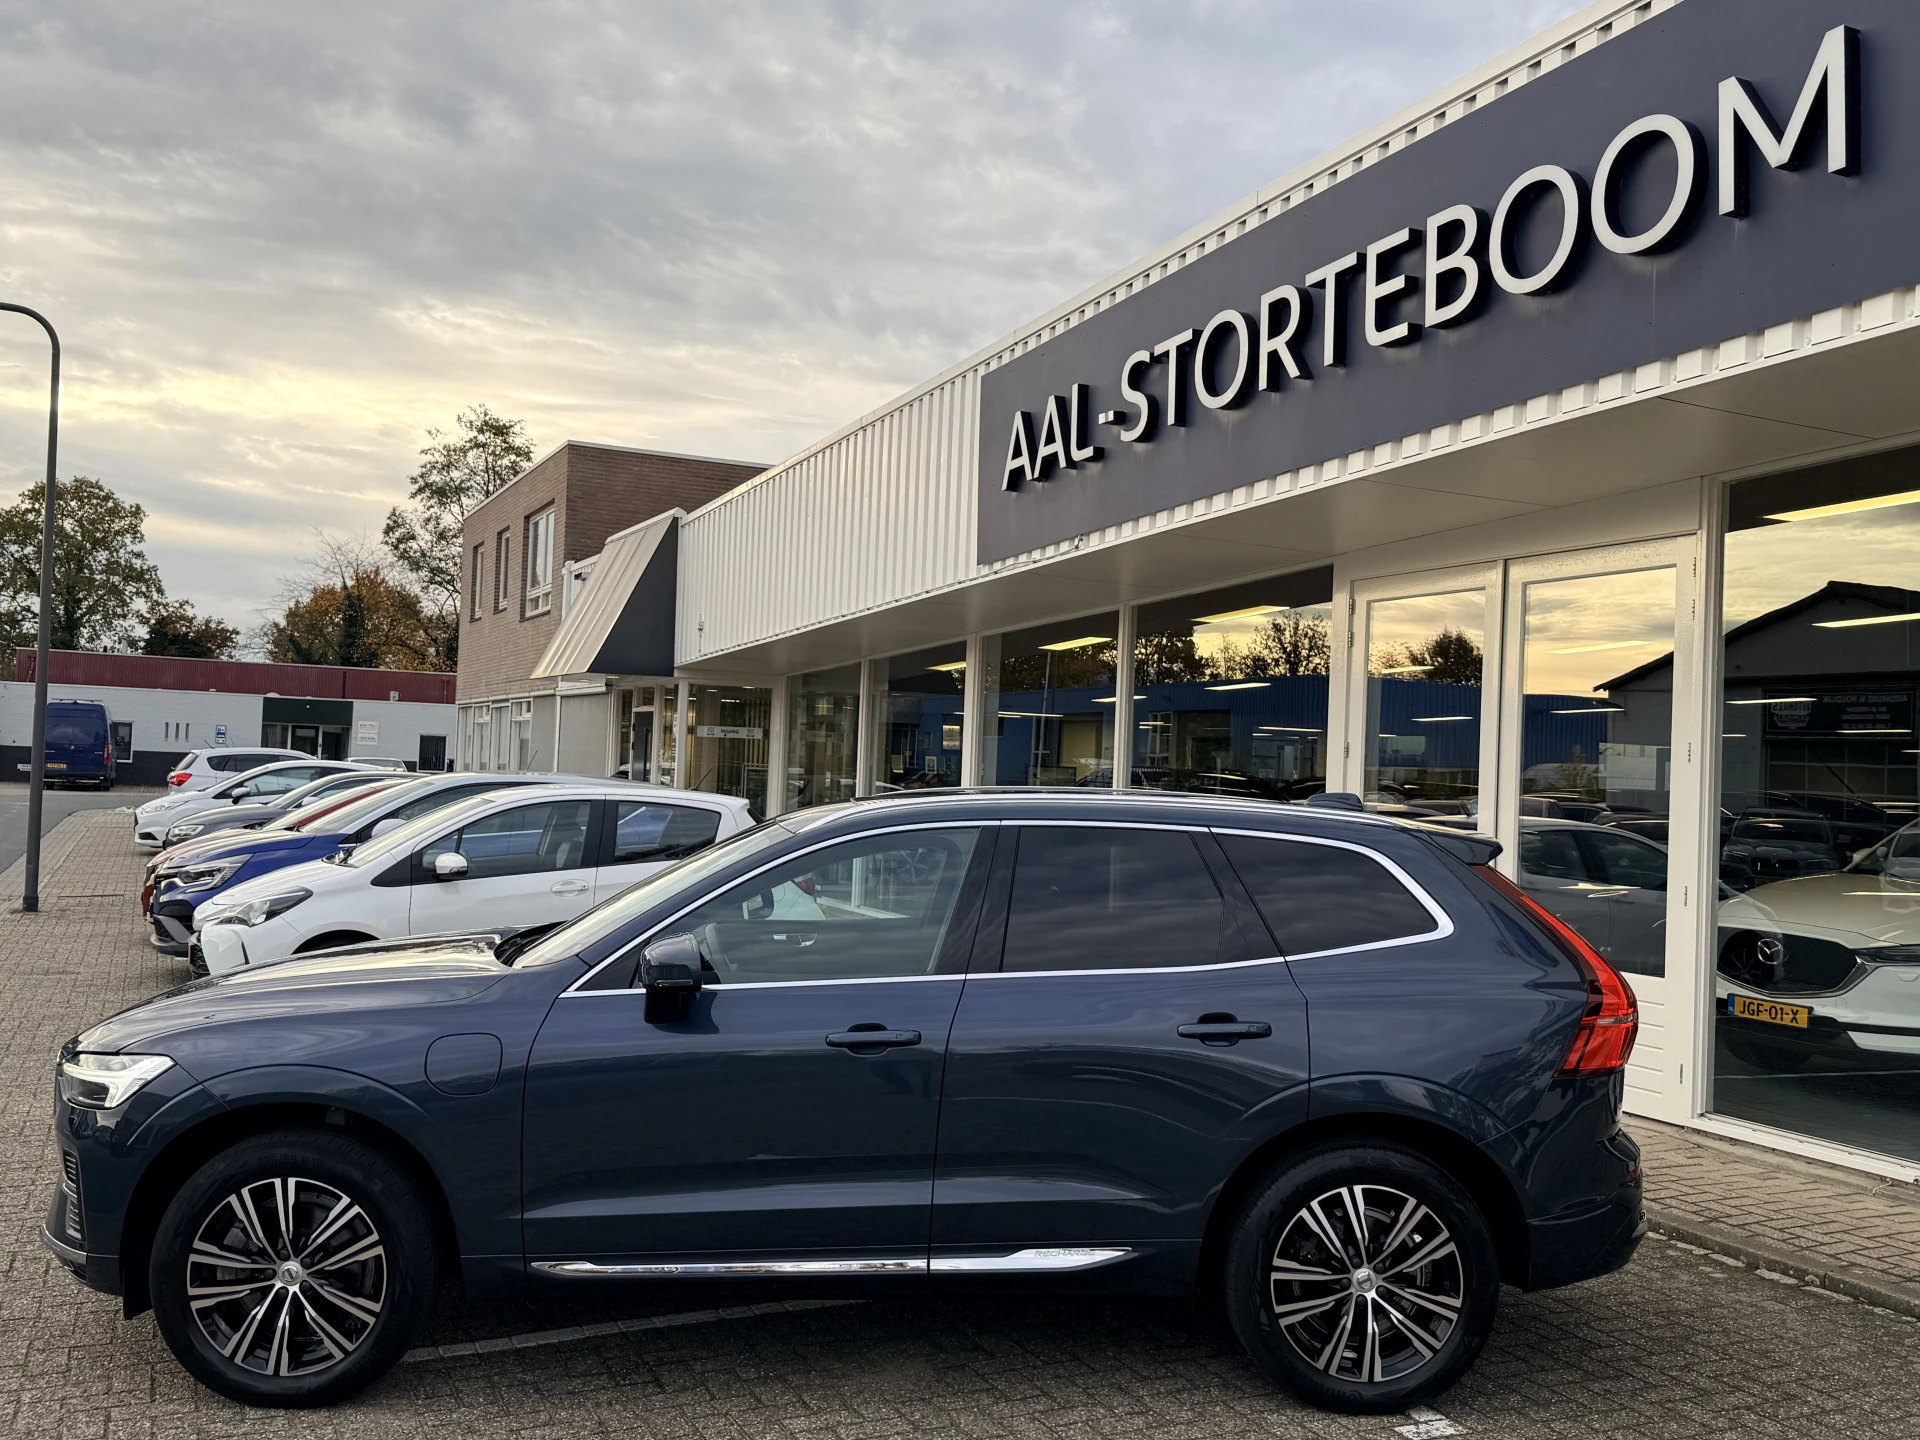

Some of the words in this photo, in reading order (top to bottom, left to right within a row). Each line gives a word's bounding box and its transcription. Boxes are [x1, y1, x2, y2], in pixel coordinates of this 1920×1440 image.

[1001, 25, 1858, 492] AAL-STORTEBOOM
[1739, 1000, 1799, 1024] JGF-01-X
[1034, 1249, 1096, 1258] RECHARGE
